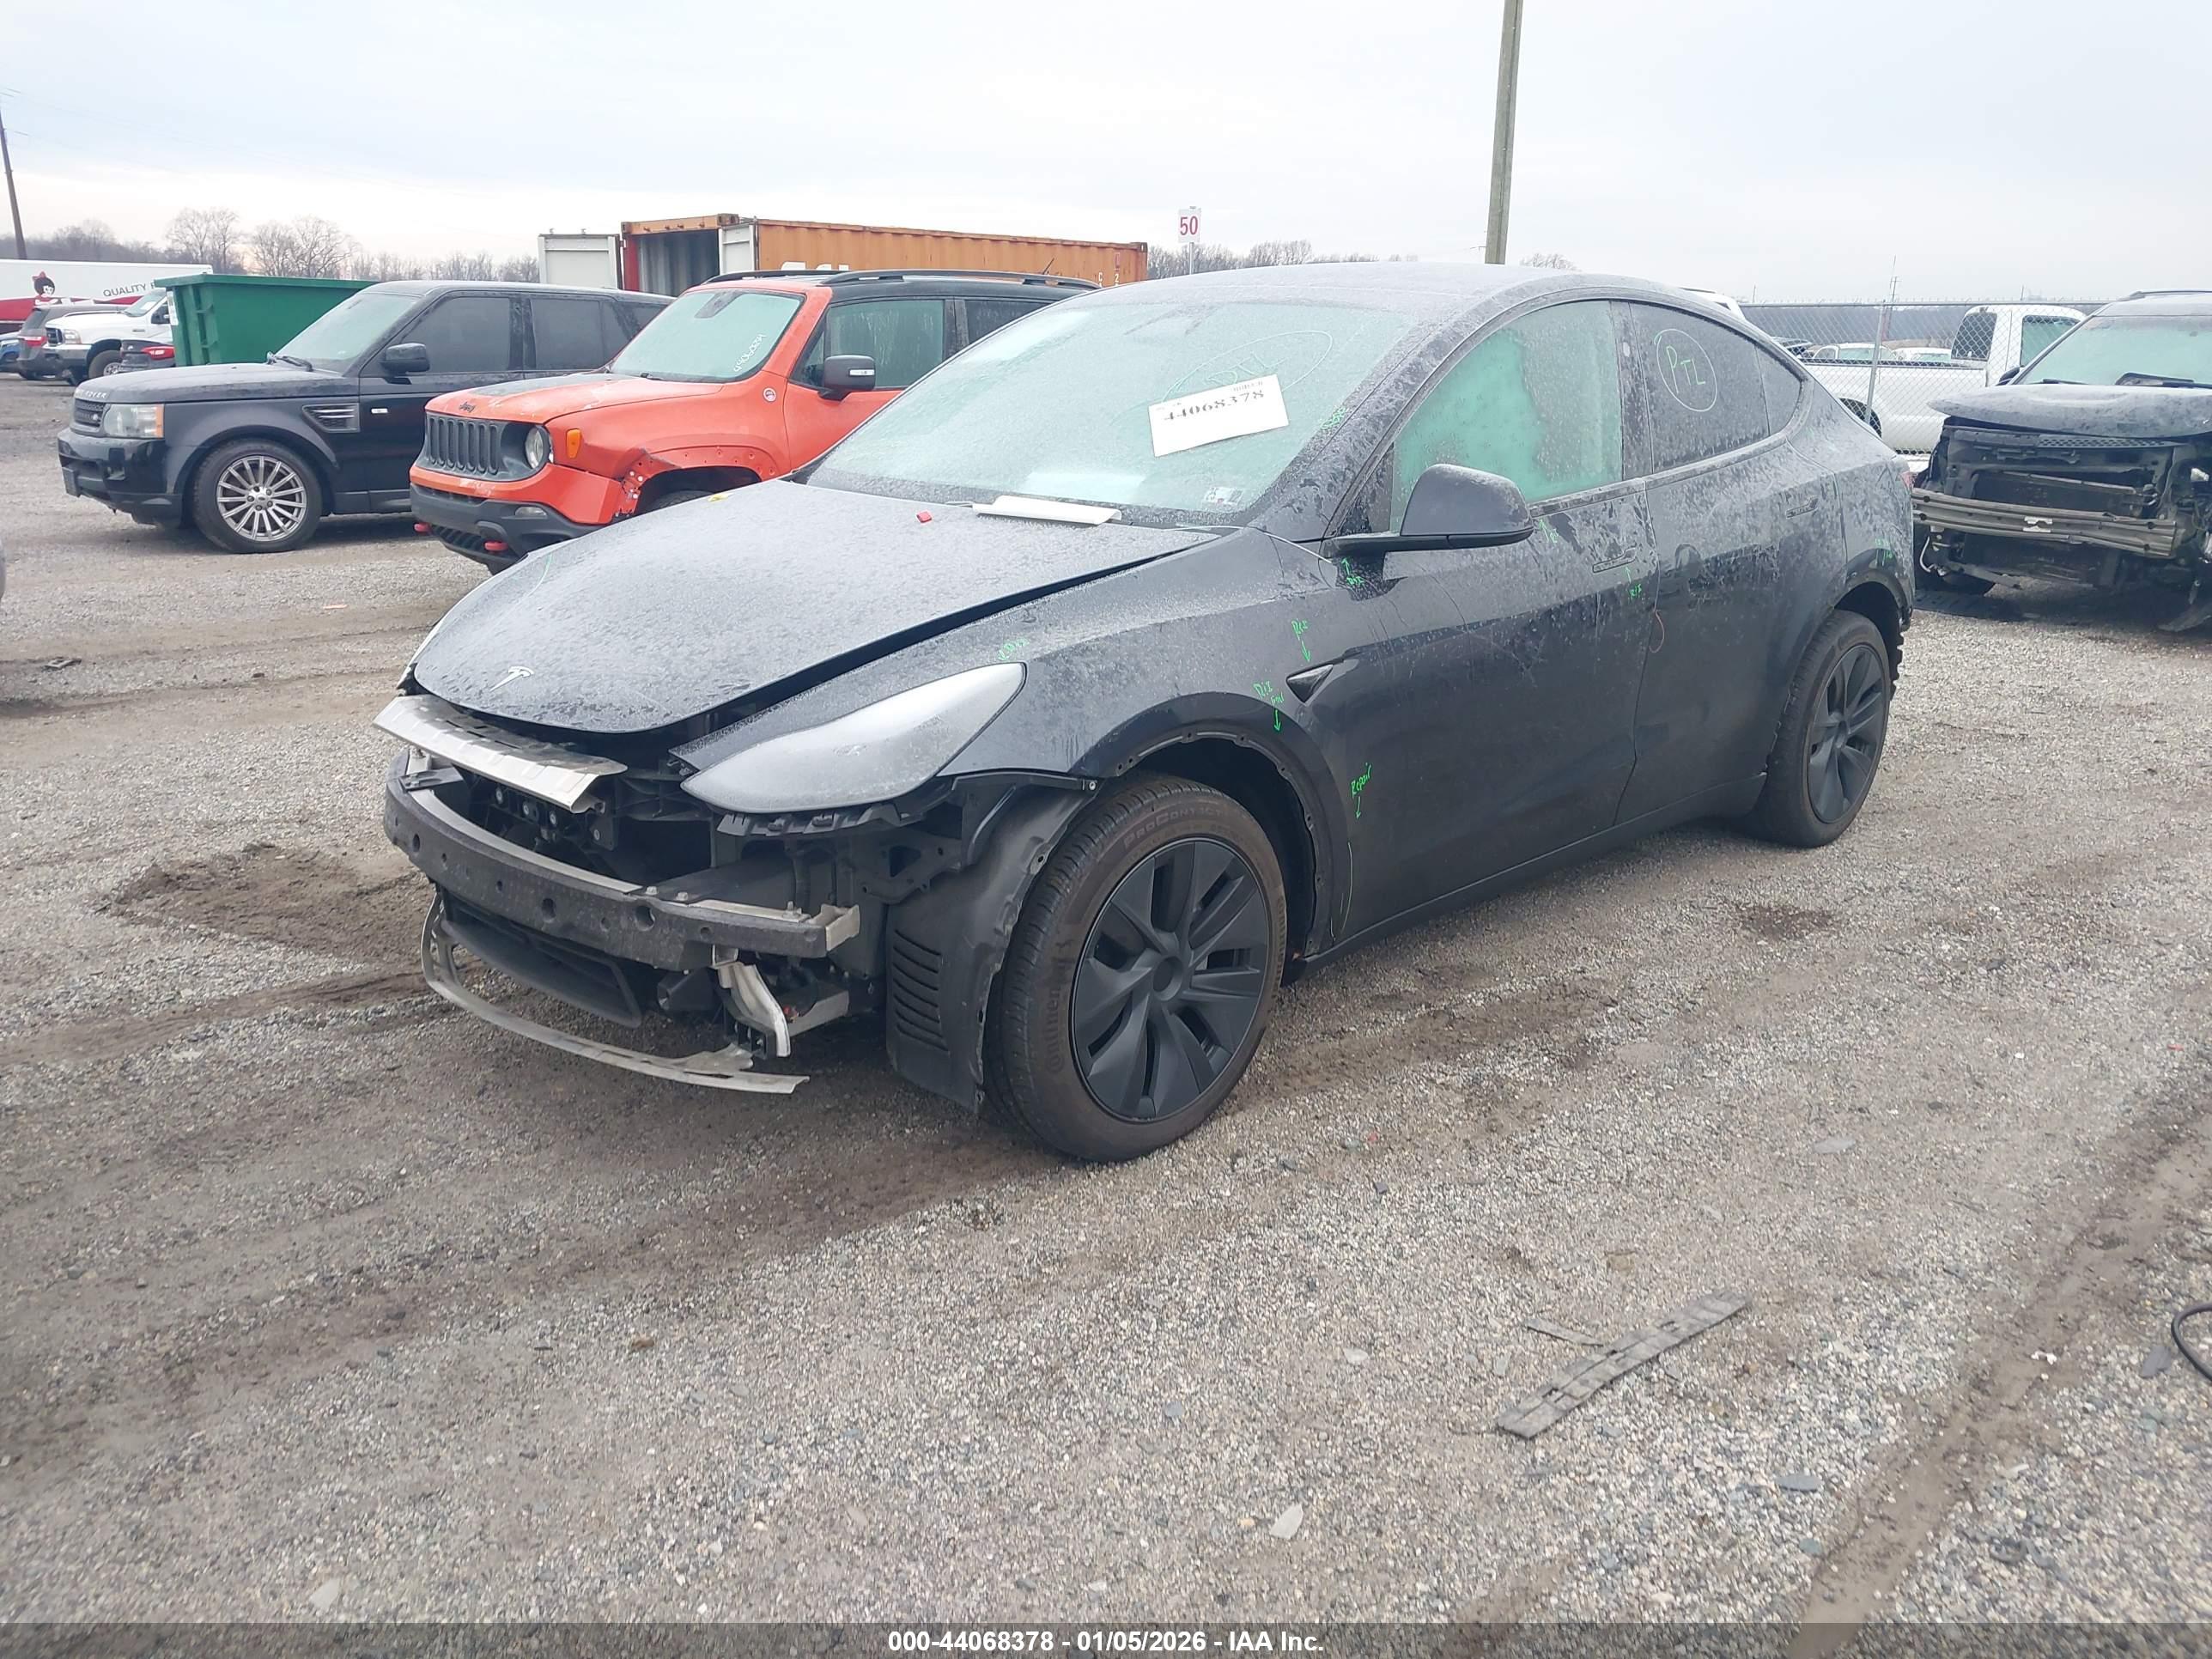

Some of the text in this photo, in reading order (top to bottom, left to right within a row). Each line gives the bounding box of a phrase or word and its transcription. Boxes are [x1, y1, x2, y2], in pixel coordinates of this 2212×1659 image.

[1180, 216, 1199, 235] 50
[103, 283, 146, 297] QUALITY
[1666, 345, 1706, 395] PTL
[1164, 390, 1265, 421] 44068378
[1351, 762, 1372, 798] Repair
